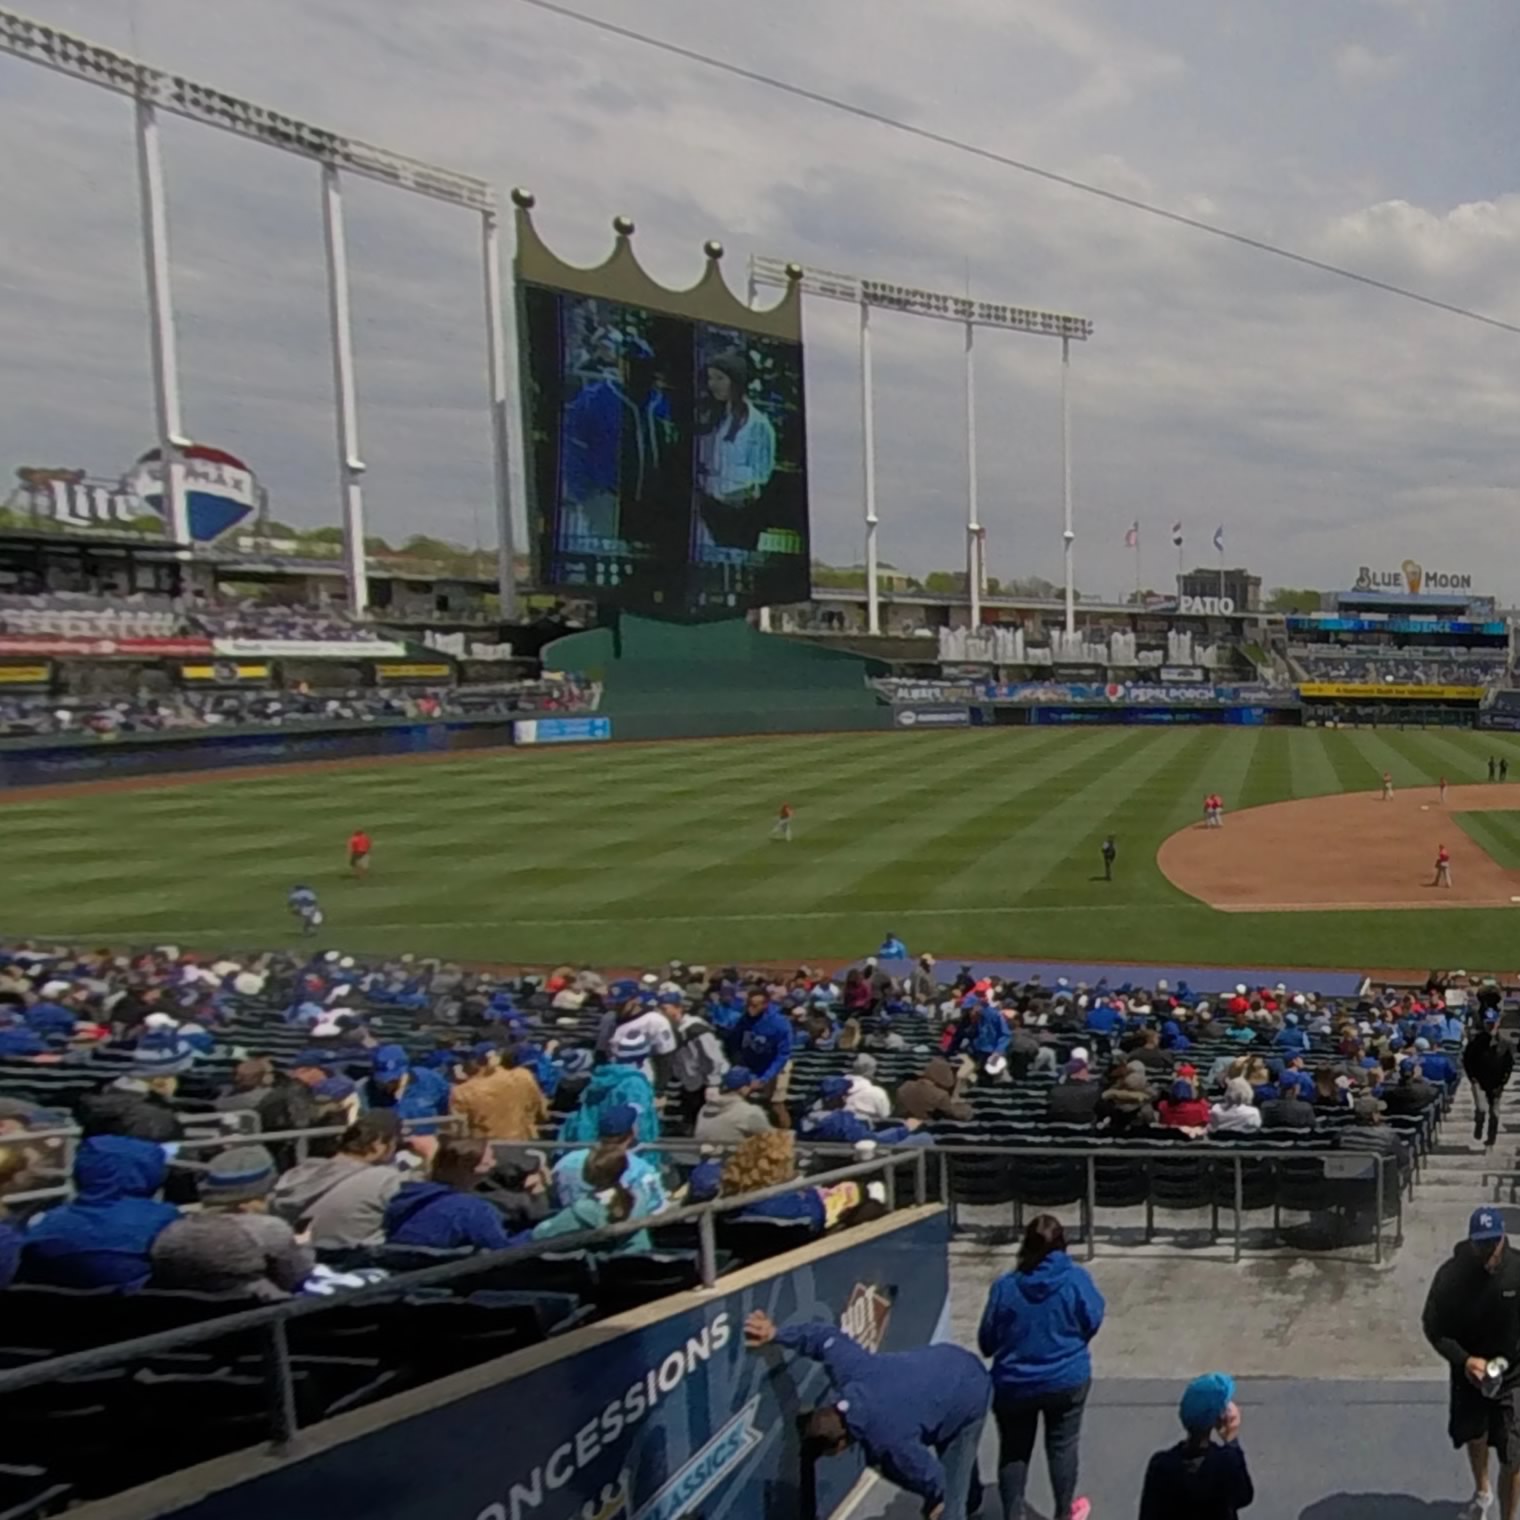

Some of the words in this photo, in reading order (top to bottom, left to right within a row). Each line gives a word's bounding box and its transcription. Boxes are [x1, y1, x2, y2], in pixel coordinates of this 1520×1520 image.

[1356, 566, 1402, 590] BLUE
[1425, 572, 1471, 589] MOON
[1180, 596, 1235, 616] PATIO
[1130, 687, 1166, 699] PEPSI
[1169, 687, 1215, 699] PORCH
